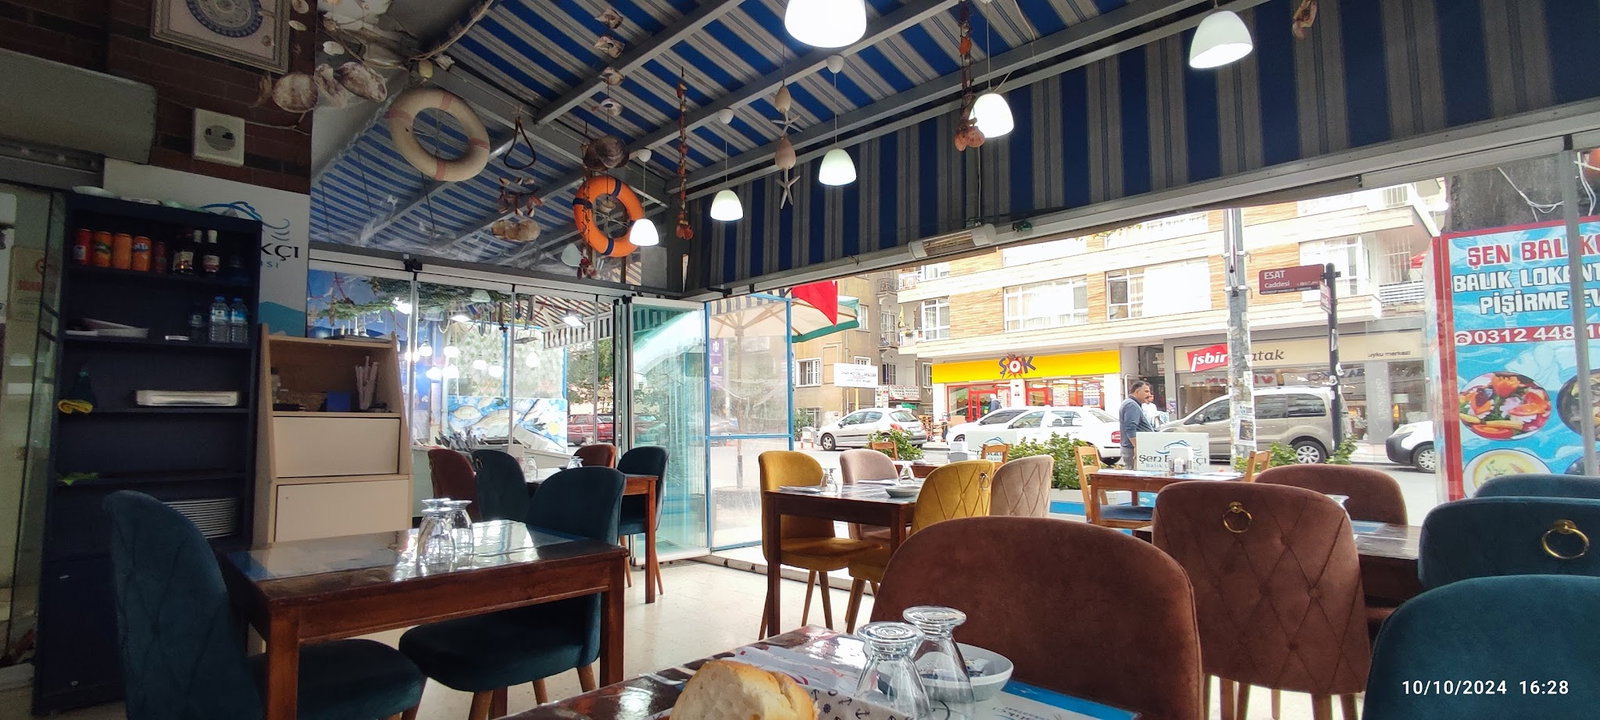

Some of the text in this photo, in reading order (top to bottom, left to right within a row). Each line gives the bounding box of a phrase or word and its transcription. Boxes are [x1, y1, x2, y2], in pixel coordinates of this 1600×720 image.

[1467, 233, 1600, 270] ŞEN BALK
[1264, 270, 1286, 280] ESAT
[1264, 280, 1291, 289] Caddesi
[1452, 270, 1514, 293] BALIK
[1480, 290, 1569, 317] PİŞİRME
[1474, 328, 1528, 344] 0312
[1533, 325, 1575, 341] 448
[999, 353, 1037, 379] ŞOK
[1251, 349, 1284, 362] atak
